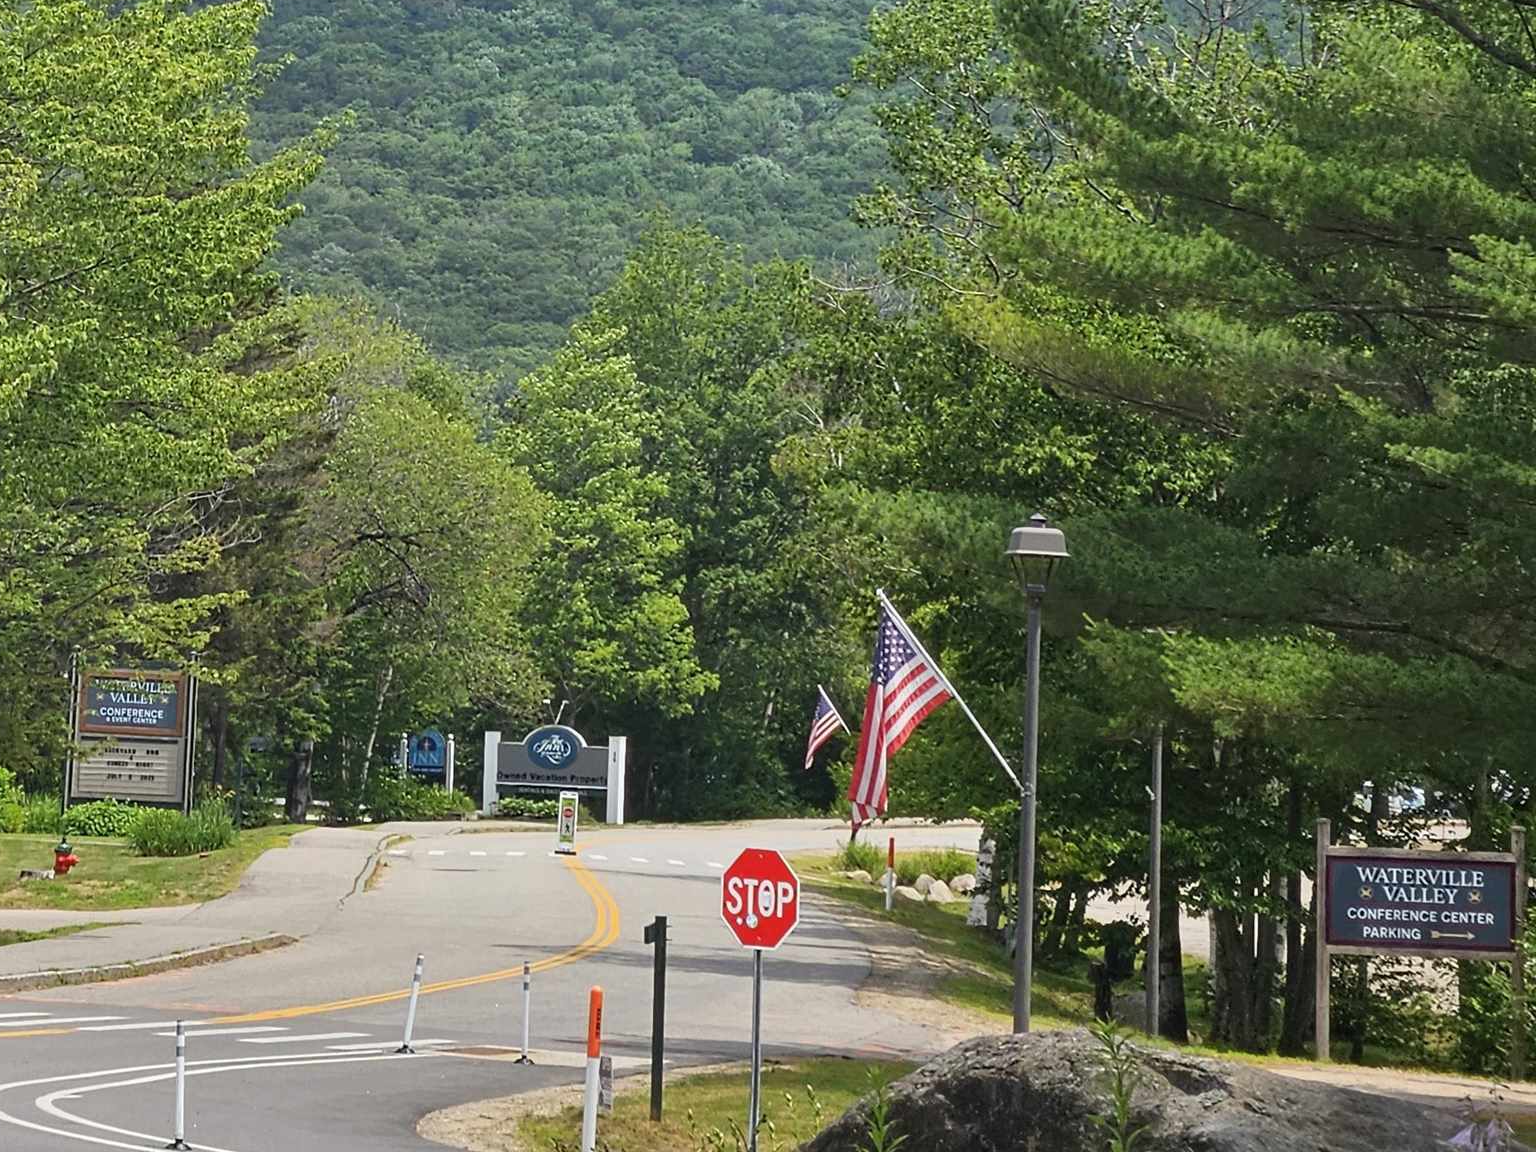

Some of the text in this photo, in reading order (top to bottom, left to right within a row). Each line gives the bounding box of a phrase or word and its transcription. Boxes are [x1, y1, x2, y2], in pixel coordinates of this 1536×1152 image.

[110, 692, 157, 705] VALLEY
[100, 707, 164, 719] CONFERENCE
[530, 772, 568, 783] Vacation
[1356, 865, 1484, 887] WATERVILLE
[726, 876, 794, 918] STOP
[1382, 885, 1458, 904] VALLEY
[1347, 907, 1495, 925] CONFERENCE CENTER
[1363, 926, 1422, 940] PARKING
